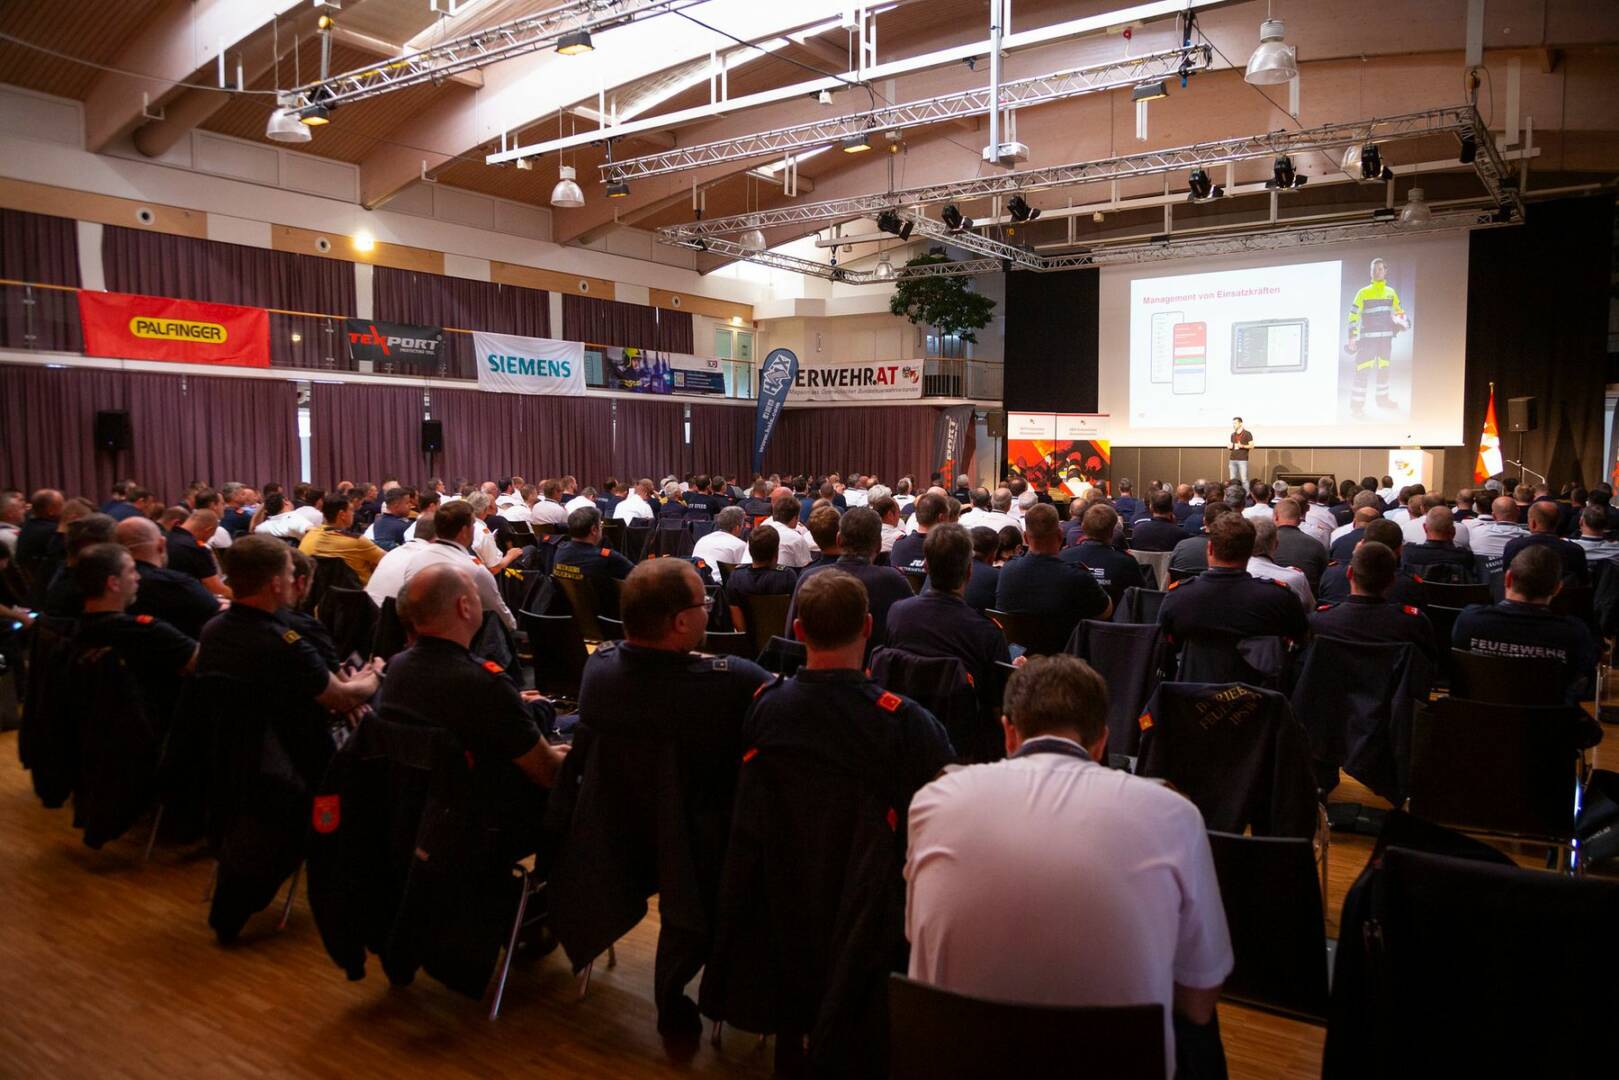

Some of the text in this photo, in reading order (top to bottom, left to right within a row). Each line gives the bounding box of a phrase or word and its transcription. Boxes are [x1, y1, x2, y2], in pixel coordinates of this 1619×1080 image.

[1142, 293, 1197, 304] Management
[1199, 291, 1215, 300] von
[136, 320, 221, 340] PALFINGER
[348, 324, 439, 355] TEXPORT
[487, 354, 571, 378] SIEMENS
[763, 354, 791, 395] HAIX
[795, 366, 899, 387] ERWEHR.AT
[1470, 637, 1567, 660] FEUERWEHR
